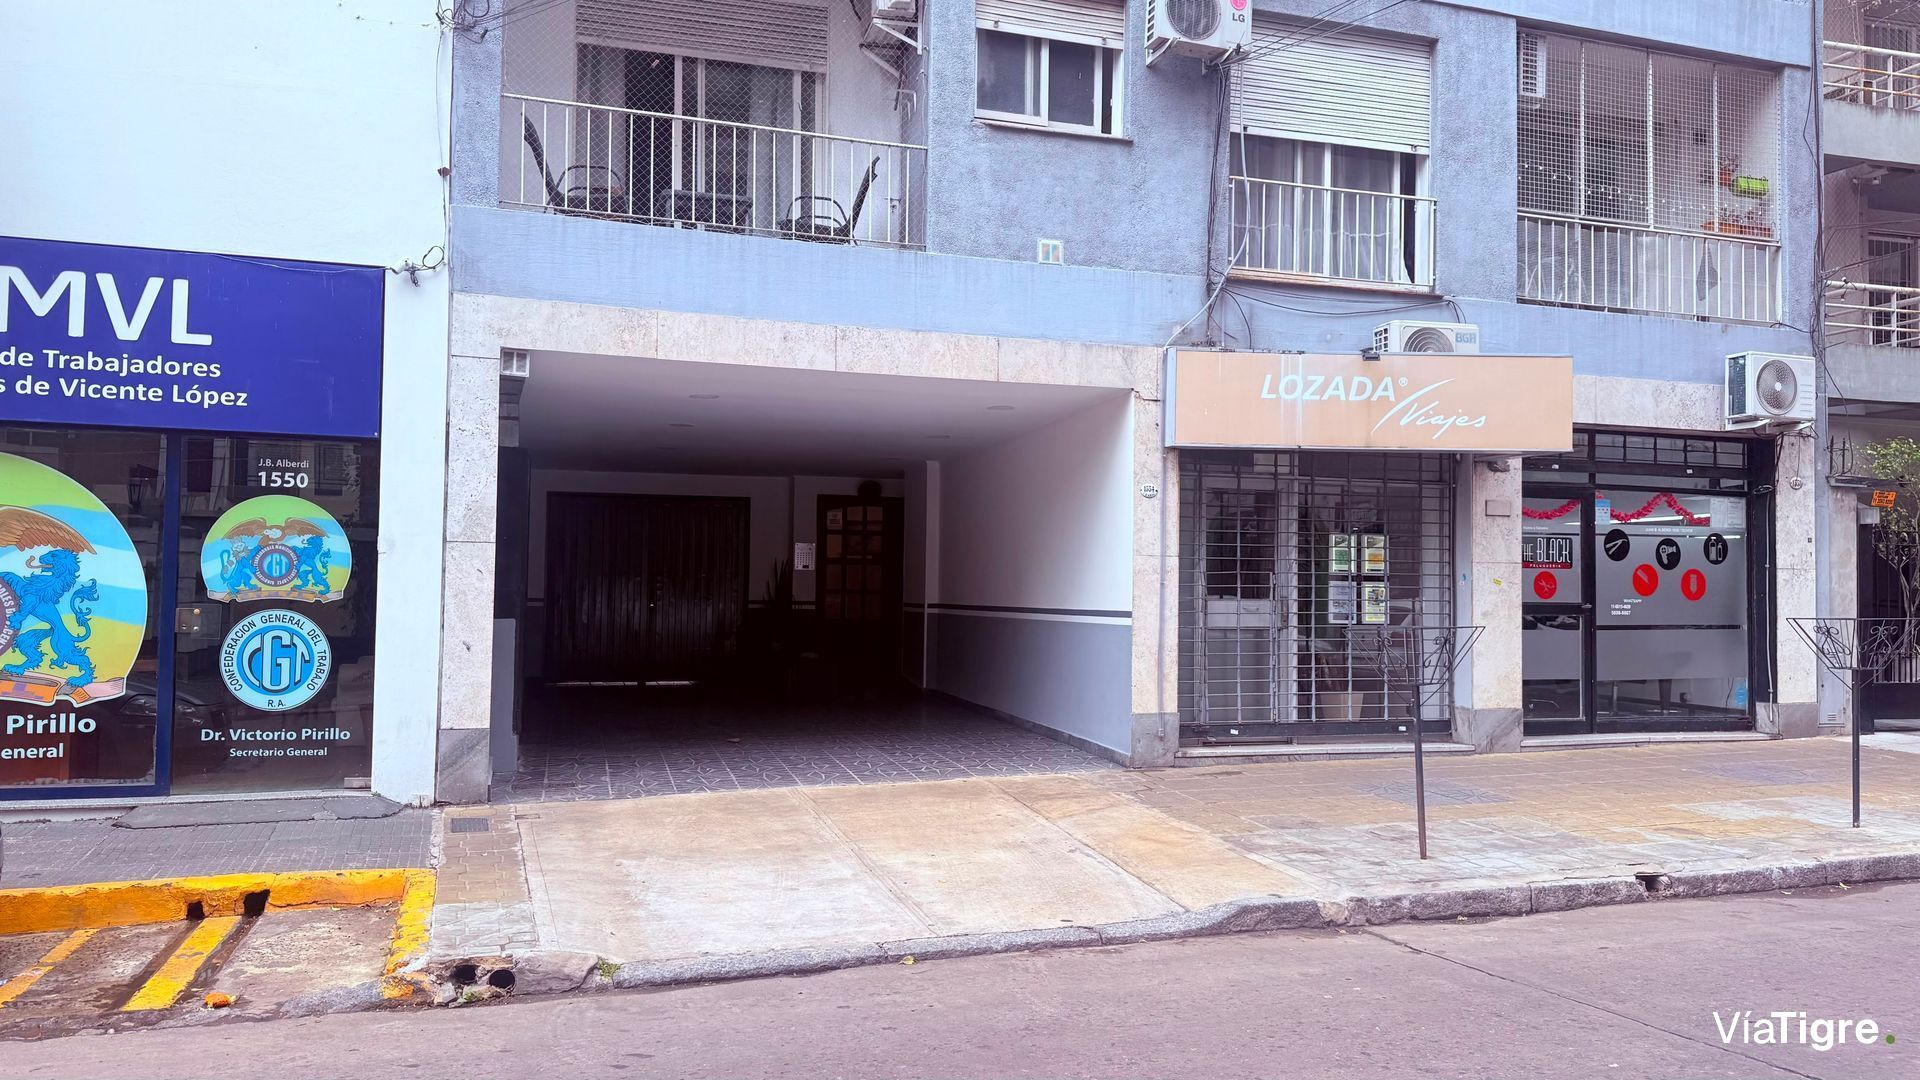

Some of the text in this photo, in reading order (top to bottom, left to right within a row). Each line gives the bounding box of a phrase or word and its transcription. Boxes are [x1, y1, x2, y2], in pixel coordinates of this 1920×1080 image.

[1232, 12, 1246, 23] LG
[0, 265, 213, 346] MVL
[1455, 332, 1478, 345] BGH
[0, 346, 221, 378] de Trabajadores
[15, 374, 50, 396] de
[58, 377, 163, 402] Vicente
[172, 384, 248, 409] López
[1399, 400, 1487, 440] Viajes
[258, 458, 310, 469] J.B. Alberdi
[258, 471, 309, 488] 1550
[1536, 537, 1571, 563] BLACK
[223, 613, 327, 692] CONFEDERACION GENERAL DEL TRABAJO
[241, 628, 311, 694] CGT
[6, 713, 97, 735] Pirillo
[200, 728, 351, 741] Dr. Victorio Pirillo
[229, 747, 328, 757] Secretario General
